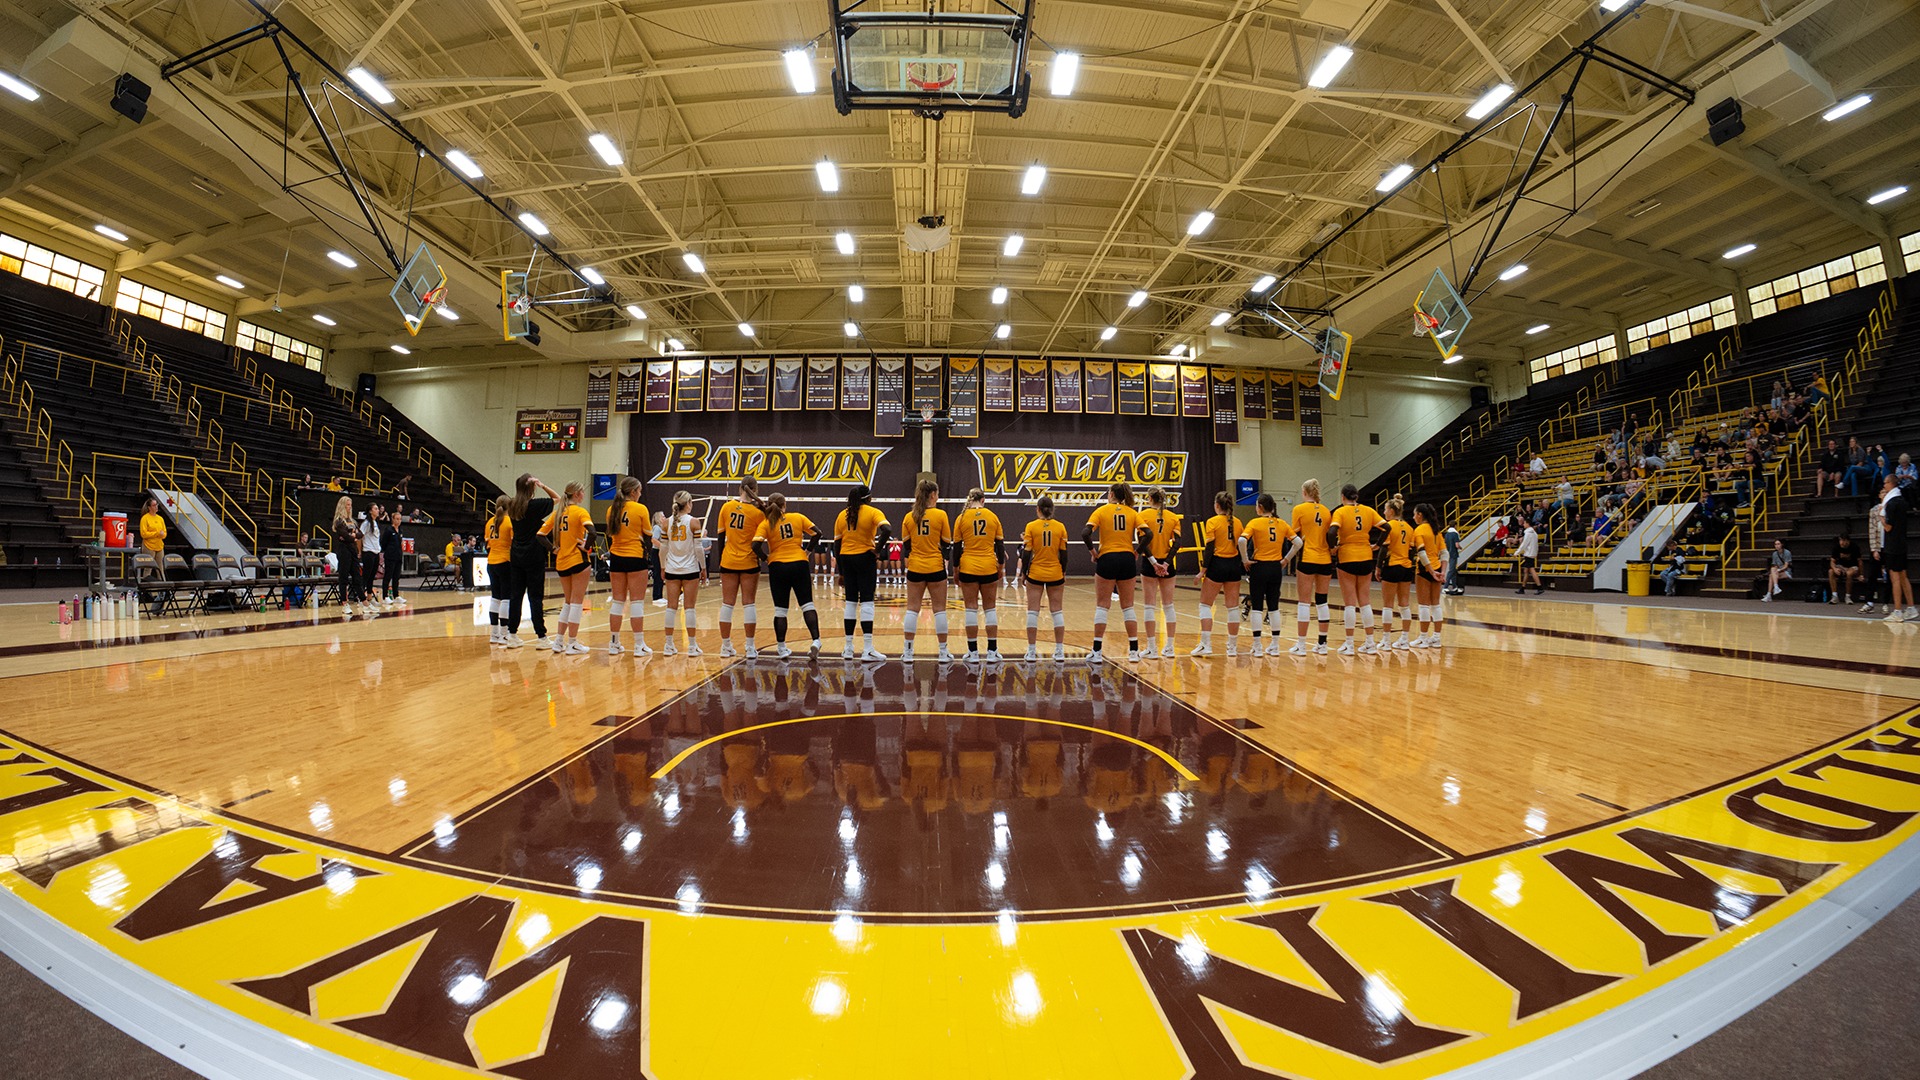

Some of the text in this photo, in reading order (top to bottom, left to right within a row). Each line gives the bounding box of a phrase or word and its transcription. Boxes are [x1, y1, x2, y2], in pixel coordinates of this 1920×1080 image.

[647, 438, 894, 489] BALDWIN
[967, 447, 1189, 495] WALLACE
[117, 522, 124, 531] G
[729, 512, 745, 529] 20
[917, 519, 930, 535] 15
[973, 519, 987, 536] 12
[1113, 514, 1126, 531] 10
[1156, 518, 1164, 534] 7
[1314, 512, 1323, 527] 4
[1355, 516, 1363, 531] 3
[671, 525, 687, 541] 23
[780, 523, 794, 540] 19
[1042, 530, 1052, 547] 11
[1269, 527, 1277, 542] 5
[1401, 529, 1407, 545] 2
[1119, 712, 1920, 1080] ALDWIN
